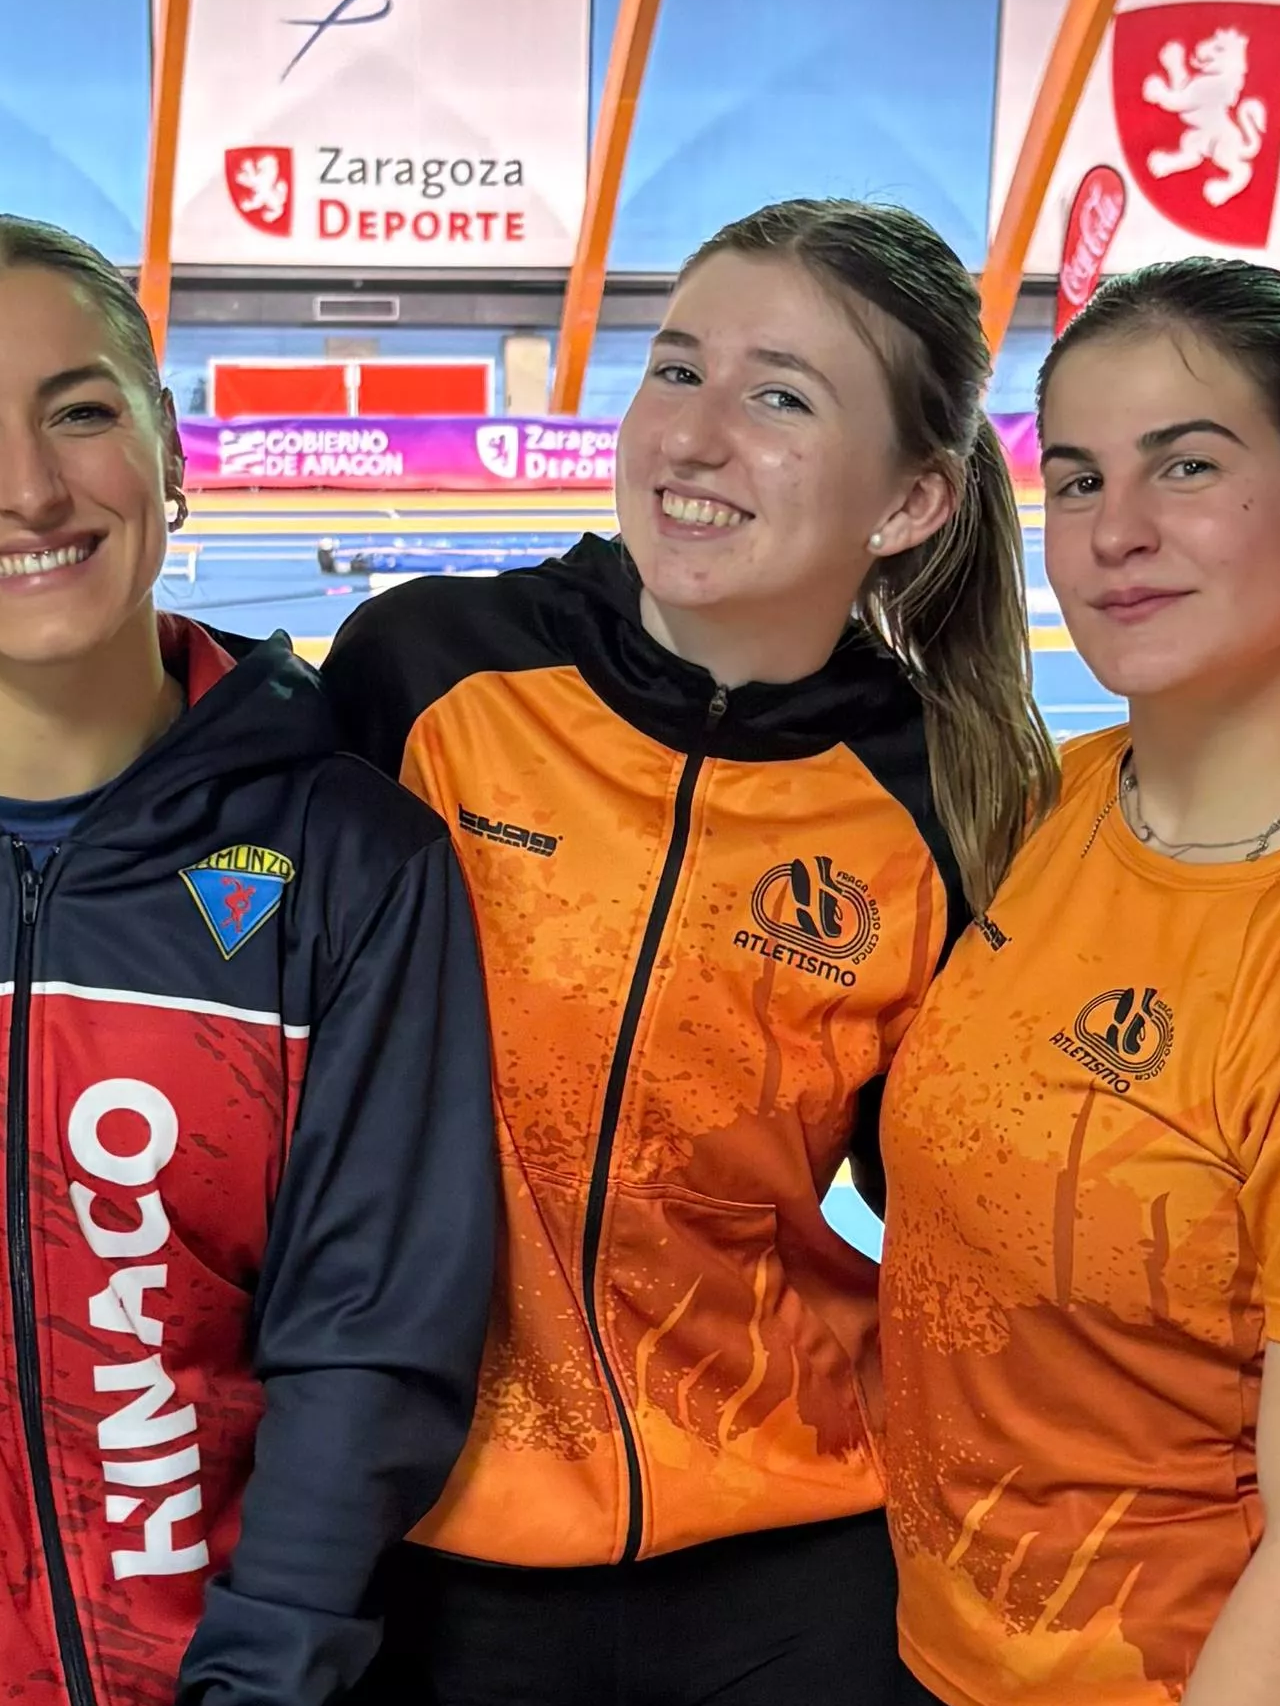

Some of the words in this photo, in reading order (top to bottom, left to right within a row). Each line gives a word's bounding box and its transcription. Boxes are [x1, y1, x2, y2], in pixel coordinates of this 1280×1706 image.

[318, 146, 524, 200] Zaragoza
[318, 197, 526, 242] DEPORTE
[265, 429, 389, 454] GOBIERNO
[524, 424, 616, 458] Zarago
[266, 454, 299, 477] DE
[525, 452, 616, 480] DEPOR
[836, 871, 869, 893] FRAGA
[868, 899, 881, 931] BAJO
[733, 930, 856, 987] ATLETISMO
[851, 934, 879, 965] CINCA
[1049, 1031, 1131, 1094] ATLETISMO
